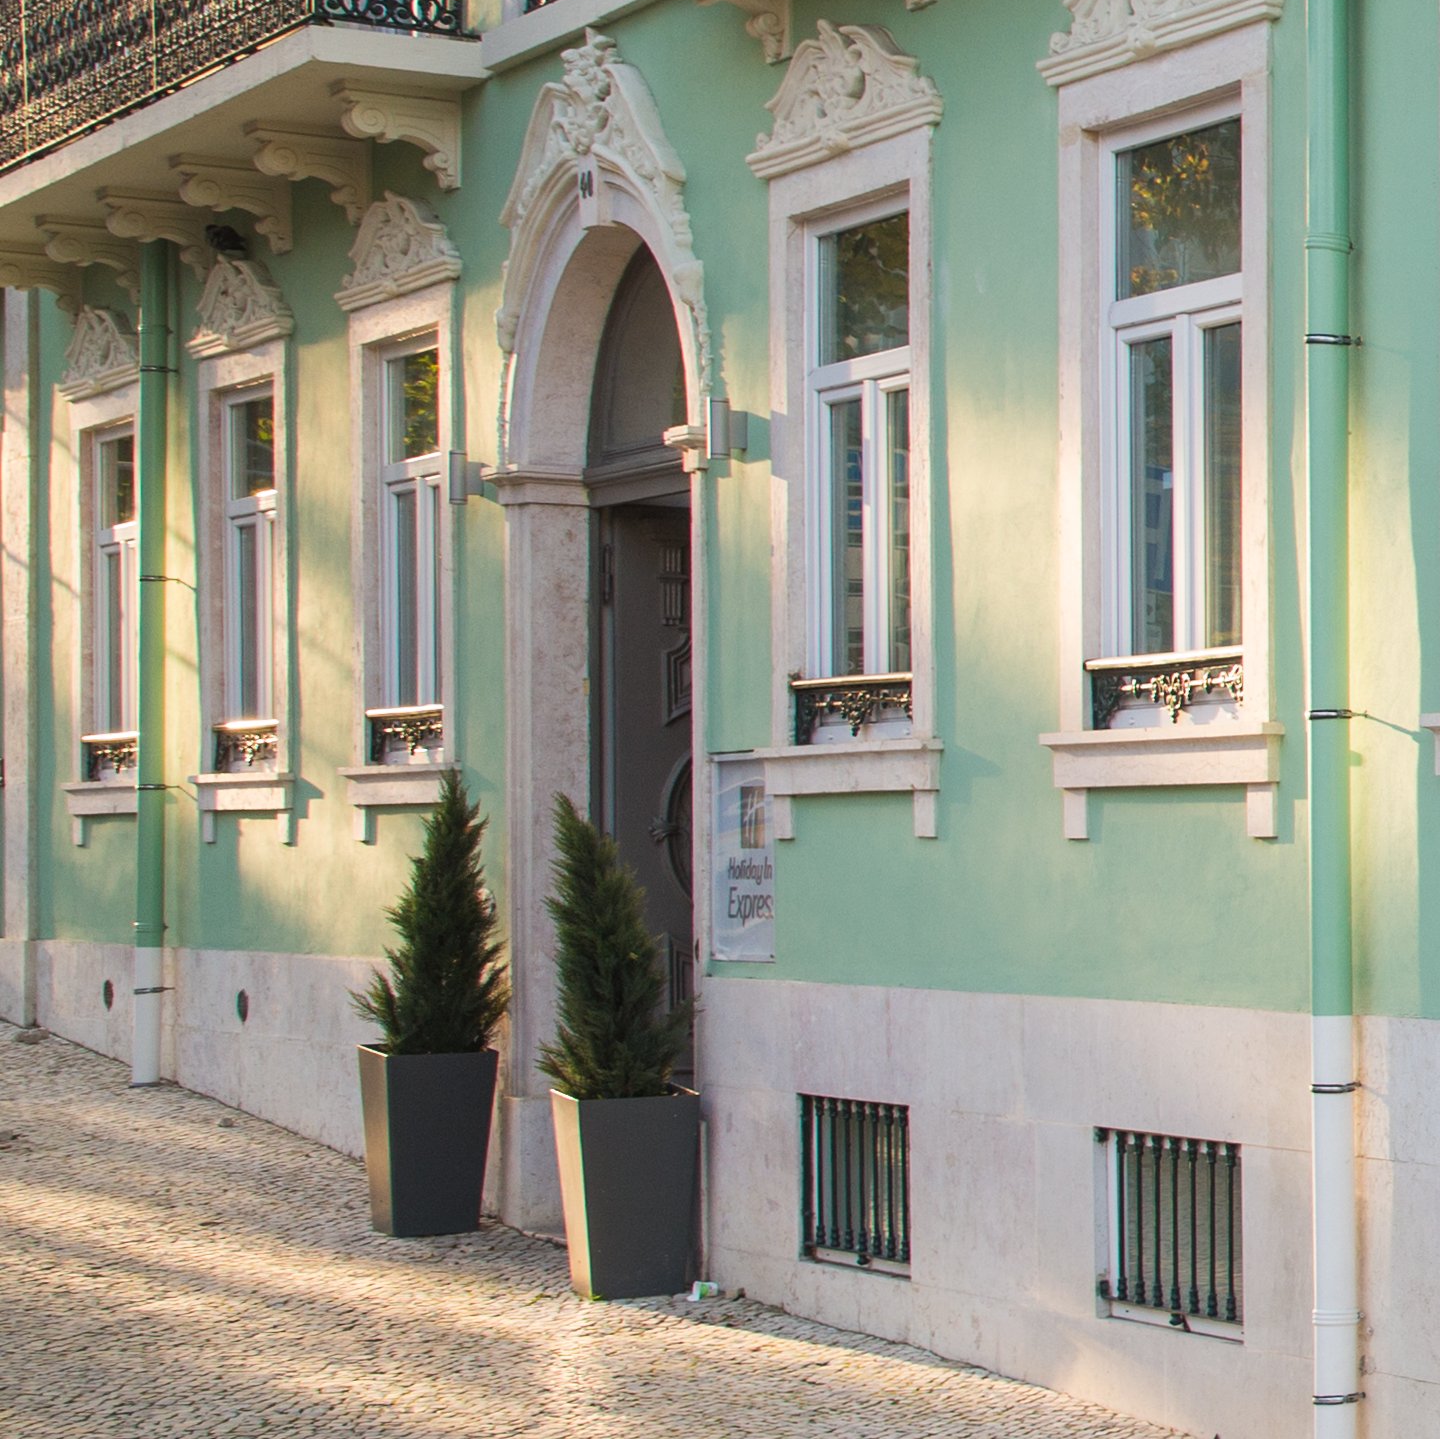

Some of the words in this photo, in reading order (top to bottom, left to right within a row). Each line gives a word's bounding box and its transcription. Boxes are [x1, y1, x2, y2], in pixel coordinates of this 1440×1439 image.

[728, 857, 763, 885] Holiday
[763, 856, 773, 880] In
[728, 886, 774, 927] Expres
